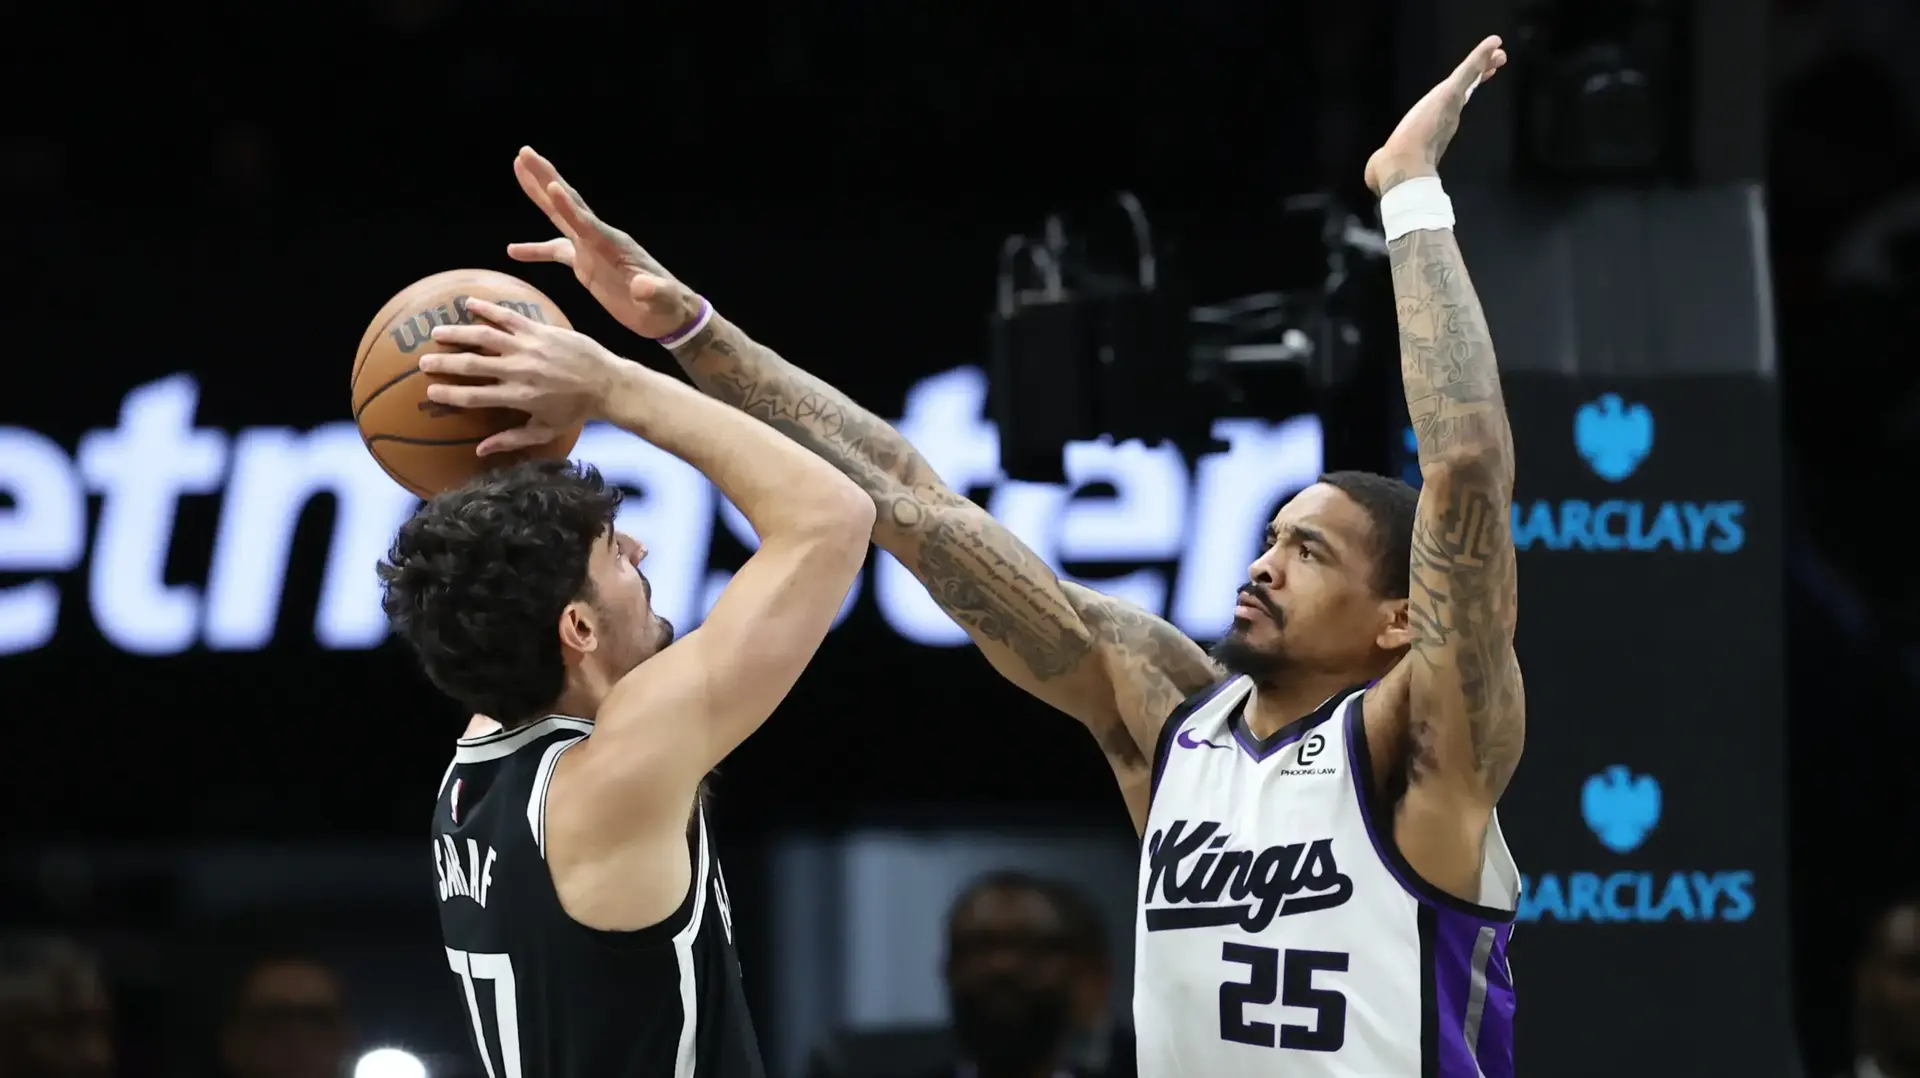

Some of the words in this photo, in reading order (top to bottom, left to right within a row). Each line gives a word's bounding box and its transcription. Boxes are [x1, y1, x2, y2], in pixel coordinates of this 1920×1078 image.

[1317, 767, 1337, 775] LAW
[1145, 819, 1354, 934] Kings
[1219, 941, 1350, 1053] 25
